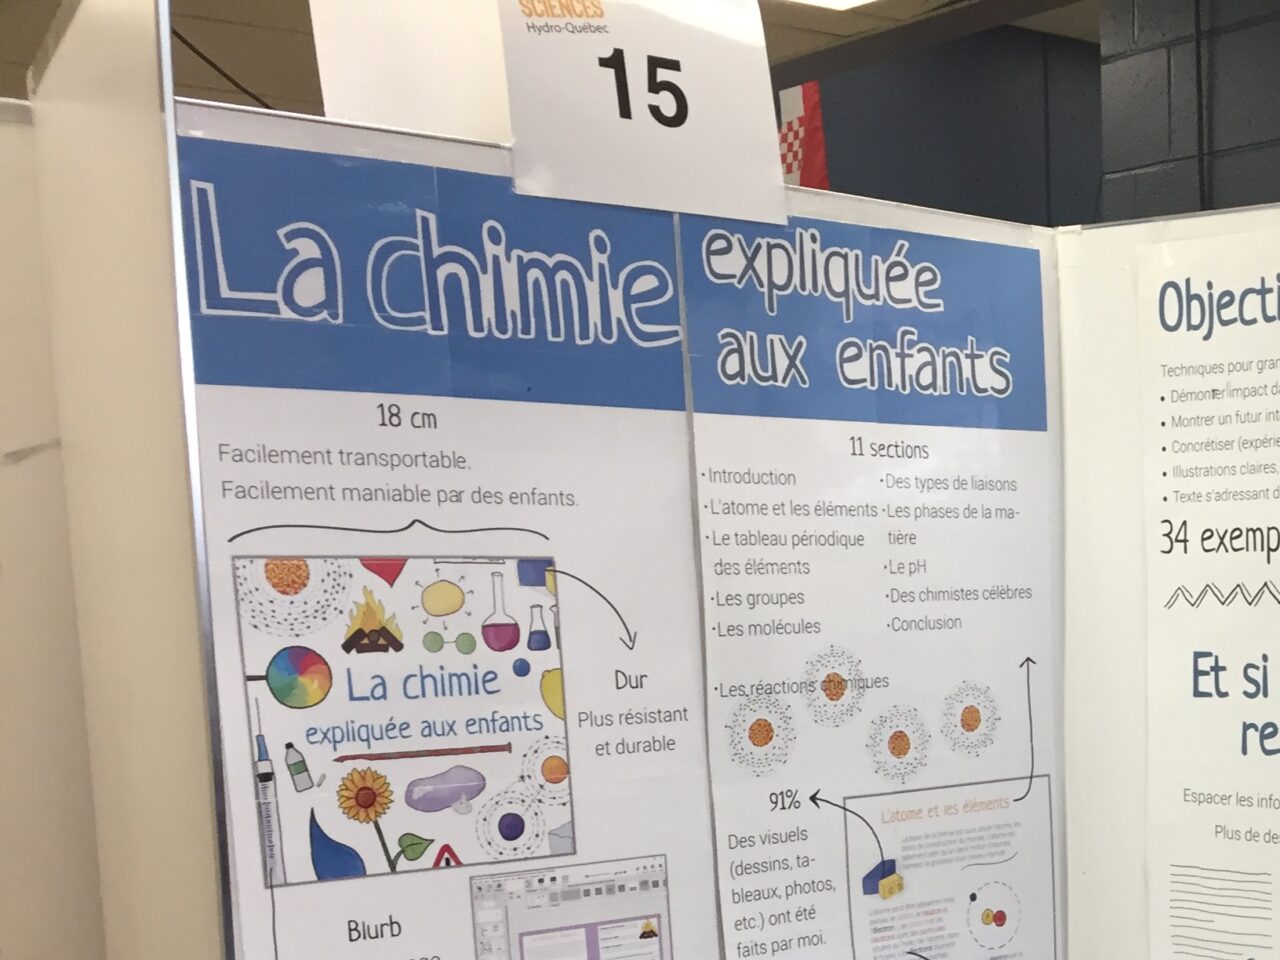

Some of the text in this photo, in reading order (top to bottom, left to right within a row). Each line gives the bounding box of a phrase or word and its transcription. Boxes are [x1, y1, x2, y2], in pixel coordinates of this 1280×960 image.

[518, 0, 605, 18] SCIENCES
[526, 22, 610, 35] Hydro-Québec
[598, 47, 688, 128] 15
[190, 179, 685, 348] La chimie
[702, 228, 944, 322] expliquée
[717, 327, 1012, 397] aux enfants
[1161, 363, 1224, 378] Techniques
[1227, 359, 1253, 375] pour
[376, 403, 437, 429] 18 cm
[1171, 414, 1215, 428] Montrer
[1218, 413, 1233, 425] un
[1235, 409, 1262, 424] futur
[849, 436, 929, 459] 11 sections
[1172, 436, 1234, 453] Concrétiser
[218, 444, 471, 470] Facilement transportable.
[709, 467, 796, 486] Introduction
[1172, 461, 1236, 478] Illustrations
[1240, 459, 1279, 475] claires,
[886, 473, 1017, 493] Des types de liaisons
[221, 481, 579, 508] Facilement maniable par des enfants.
[711, 498, 878, 517] L'atome et les éléments
[712, 531, 864, 550] Le tableau périodique
[1160, 519, 1189, 554] 34
[712, 558, 810, 576] des éléments
[889, 559, 927, 577] Le pH
[716, 591, 805, 609] Les groupes
[890, 585, 1032, 603] Des chimistes célèbres
[718, 619, 821, 637] Les molécules
[891, 616, 962, 631] Conclusion
[346, 664, 501, 701] La chimie
[614, 670, 647, 690] Dur
[1192, 651, 1229, 699] Et
[1242, 653, 1268, 699] si
[578, 705, 688, 728] Plus résistant
[305, 710, 543, 753] expliquée aux enfants
[594, 735, 675, 756] et durable
[769, 789, 801, 812] 91%
[728, 828, 808, 850] Des visuels
[730, 852, 816, 880] (dessins, ta-
[732, 880, 836, 906] bleaux, photos,
[347, 914, 402, 942] Blurb
[737, 931, 826, 958] faits par moi.
